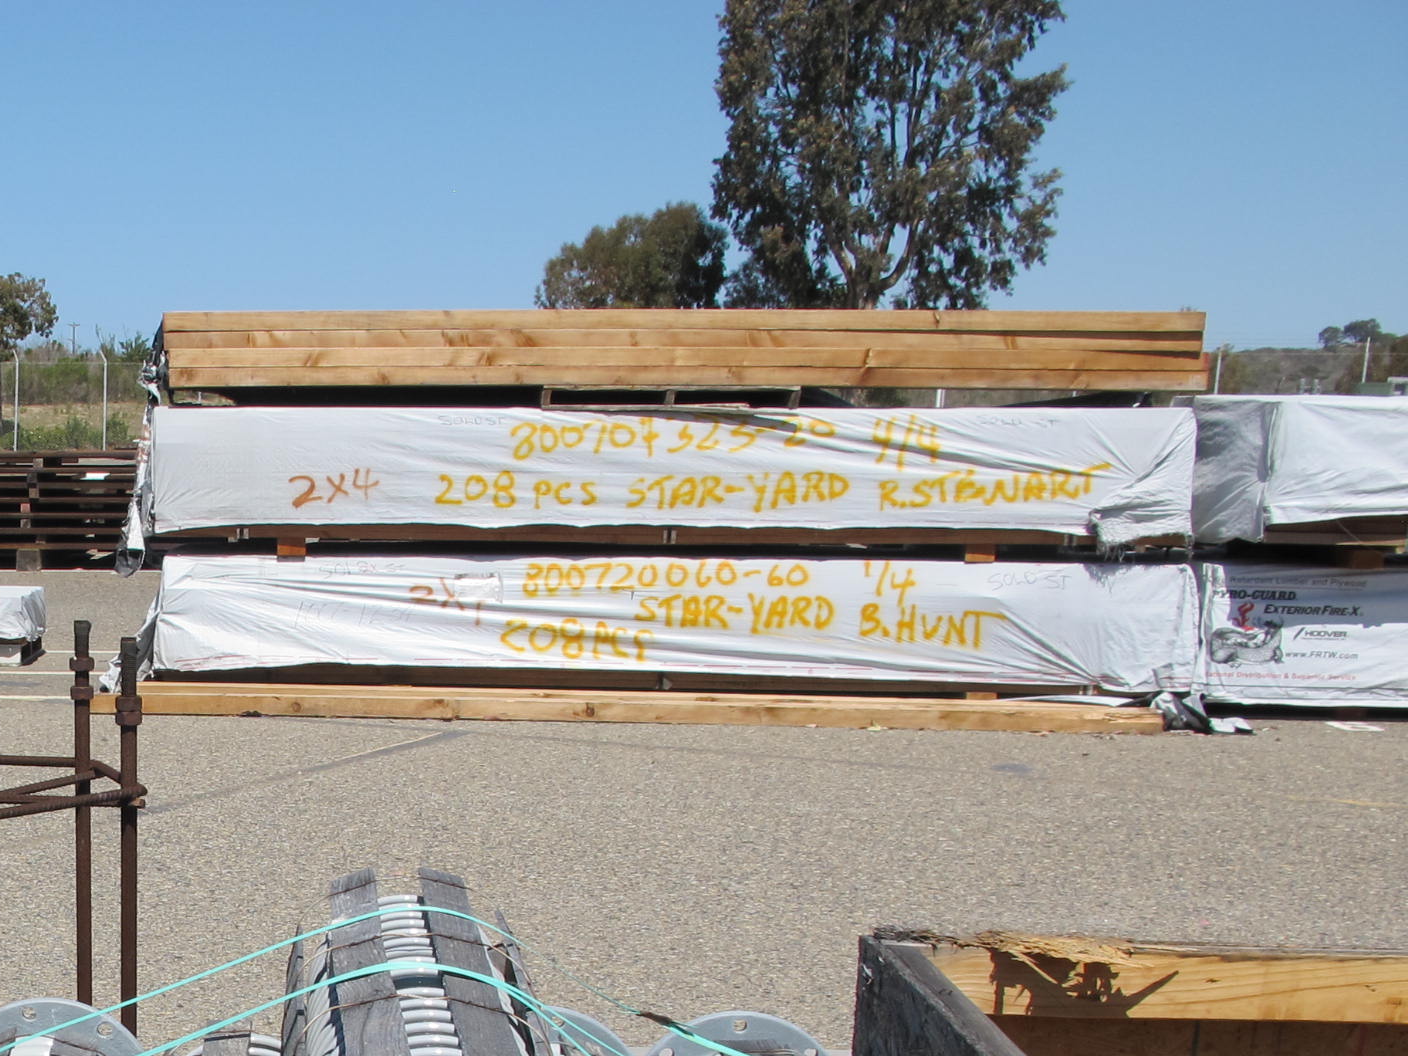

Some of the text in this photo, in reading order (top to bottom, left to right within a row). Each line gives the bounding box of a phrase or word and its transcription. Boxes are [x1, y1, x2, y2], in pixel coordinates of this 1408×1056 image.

[435, 470, 517, 508] 208
[533, 479, 598, 510] PCS
[627, 470, 851, 513] STAR-YARD
[634, 594, 835, 634] STAR-YARD
[1263, 604, 1321, 616] EXTERIOR
[500, 618, 585, 660] 208
